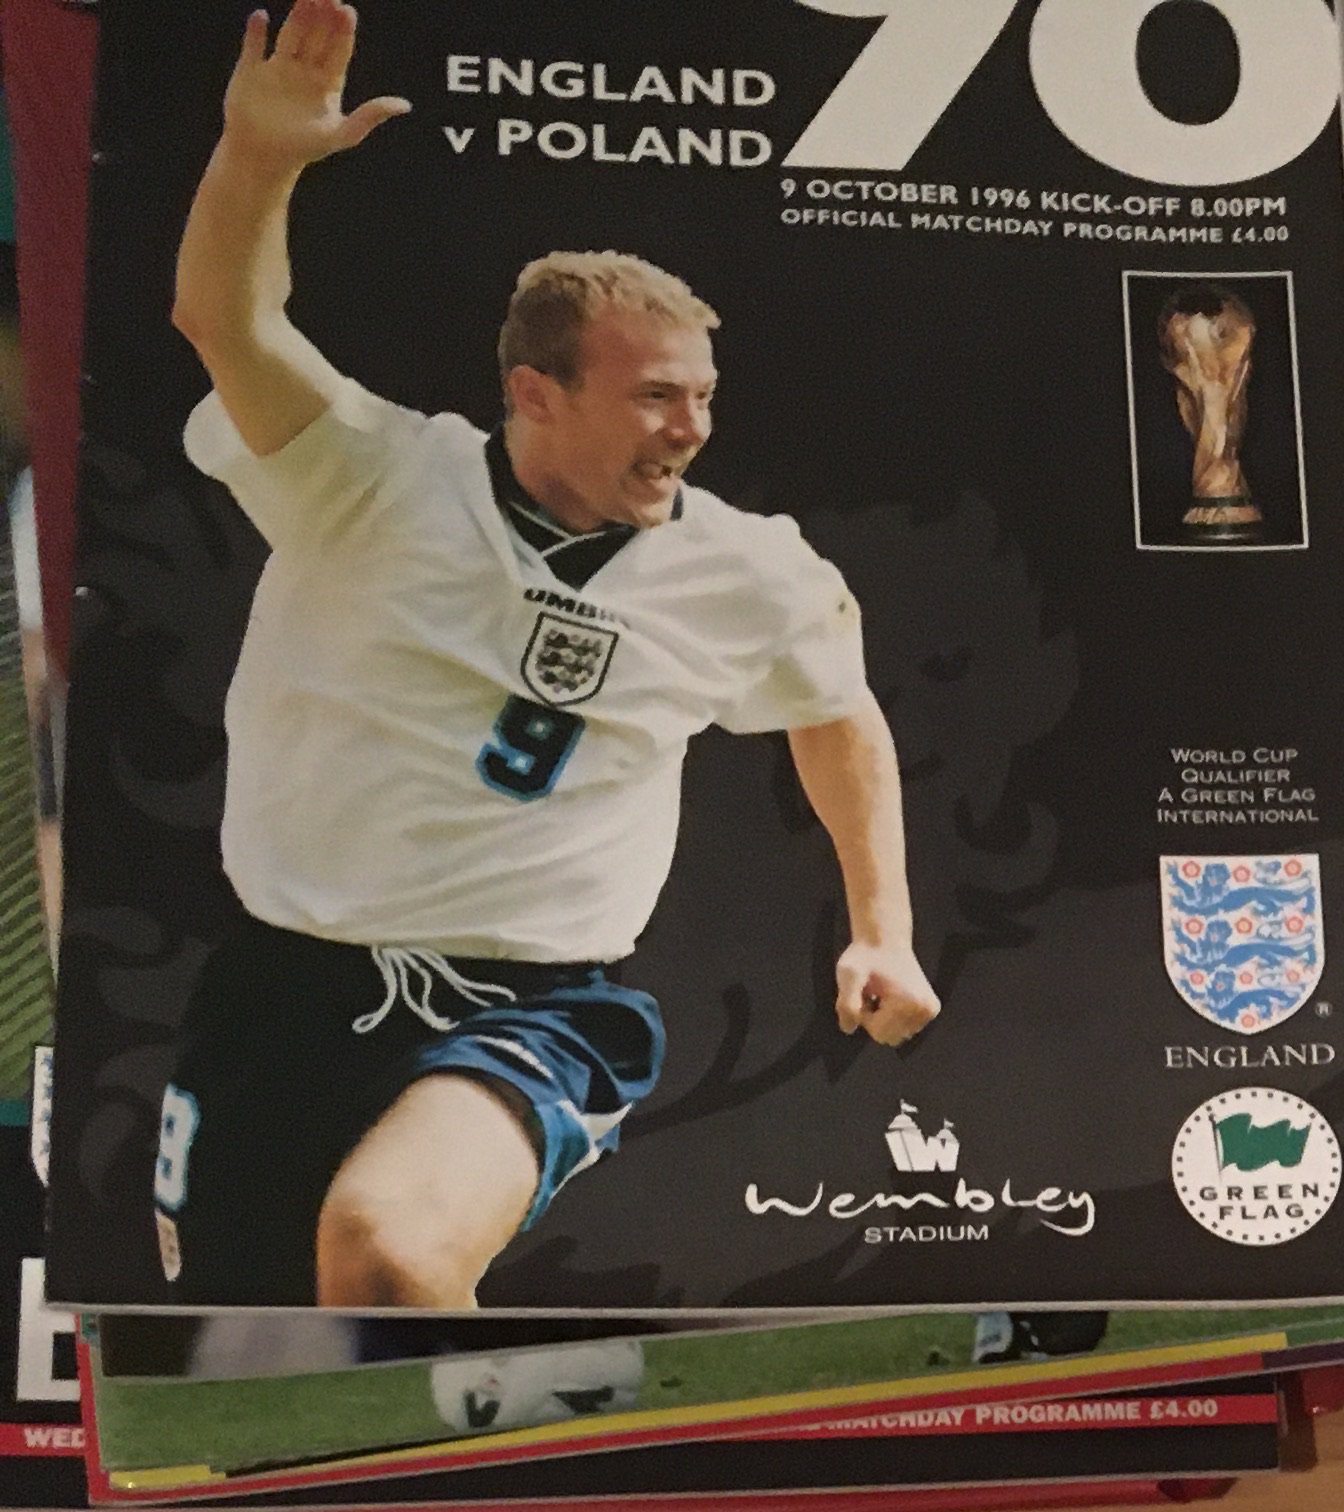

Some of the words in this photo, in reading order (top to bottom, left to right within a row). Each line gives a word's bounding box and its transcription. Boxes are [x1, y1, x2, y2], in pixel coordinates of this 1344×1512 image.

[446, 54, 777, 106] ENGLAND
[443, 125, 476, 154] v
[498, 119, 774, 168] POLAND
[781, 179, 796, 198] 9
[806, 180, 958, 204] OCTOBER
[971, 186, 1030, 210] 1996
[1040, 190, 1180, 217] KICK-OFF
[1190, 196, 1286, 217] 8.00PM
[780, 208, 901, 228] OFFICIAL
[911, 213, 1053, 237] MATCHDAY
[1063, 223, 1223, 244] PROGRAMME
[1232, 225, 1289, 243] £4.00
[1170, 747, 1247, 764] WORLD
[1253, 747, 1299, 764] CUP
[1181, 767, 1291, 784] QUALIFIER
[1158, 787, 1173, 803] A
[1181, 787, 1255, 804] GREEN
[1263, 787, 1316, 803] FLAG
[1156, 808, 1319, 824] INTERNATIONAL
[1165, 1043, 1336, 1068] ENGLAND
[1199, 1183, 1320, 1202] GREEN
[745, 1177, 1096, 1237] Wembley
[1218, 1203, 1305, 1221] FLAG
[864, 1223, 989, 1244] STADIUM
[976, 1401, 1140, 1426] PROGRAMME
[1150, 1399, 1218, 1421] £4.00
